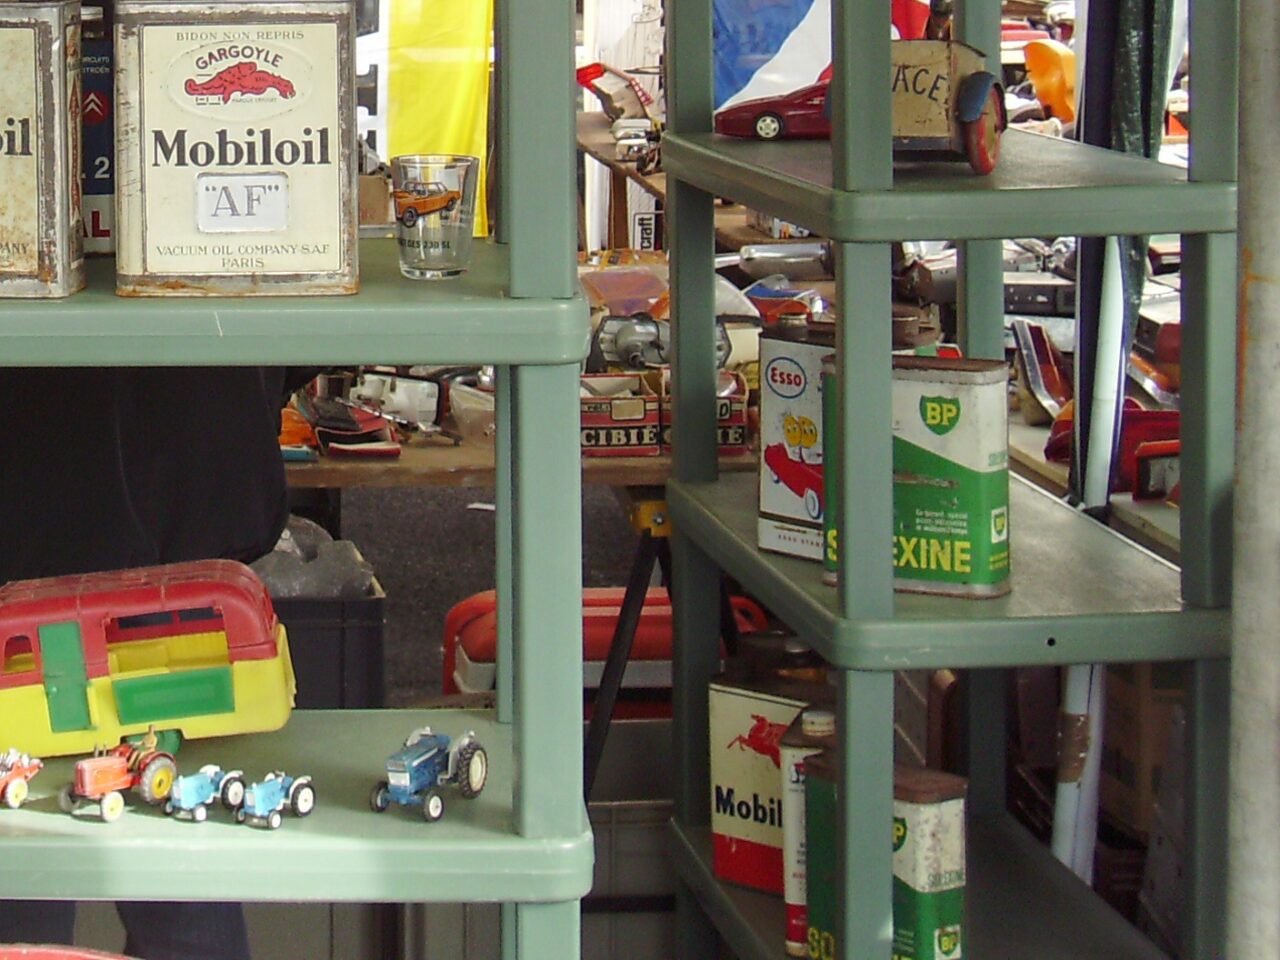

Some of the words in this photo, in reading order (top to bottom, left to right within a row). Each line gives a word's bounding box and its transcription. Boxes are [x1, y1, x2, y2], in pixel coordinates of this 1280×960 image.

[176, 31, 218, 41] BIDON
[223, 31, 250, 41] NON
[256, 30, 304, 40] REPRIS
[196, 45, 283, 70] GARGOYLE
[152, 127, 332, 167] Mobiloil
[156, 245, 208, 256] VACUUM
[211, 244, 233, 256] OIL
[238, 244, 298, 256] COMPANY
[221, 257, 265, 269] PARIS
[925, 402, 958, 426] BP
[581, 424, 657, 447] CIBIÉ
[715, 785, 783, 828] Mobil
